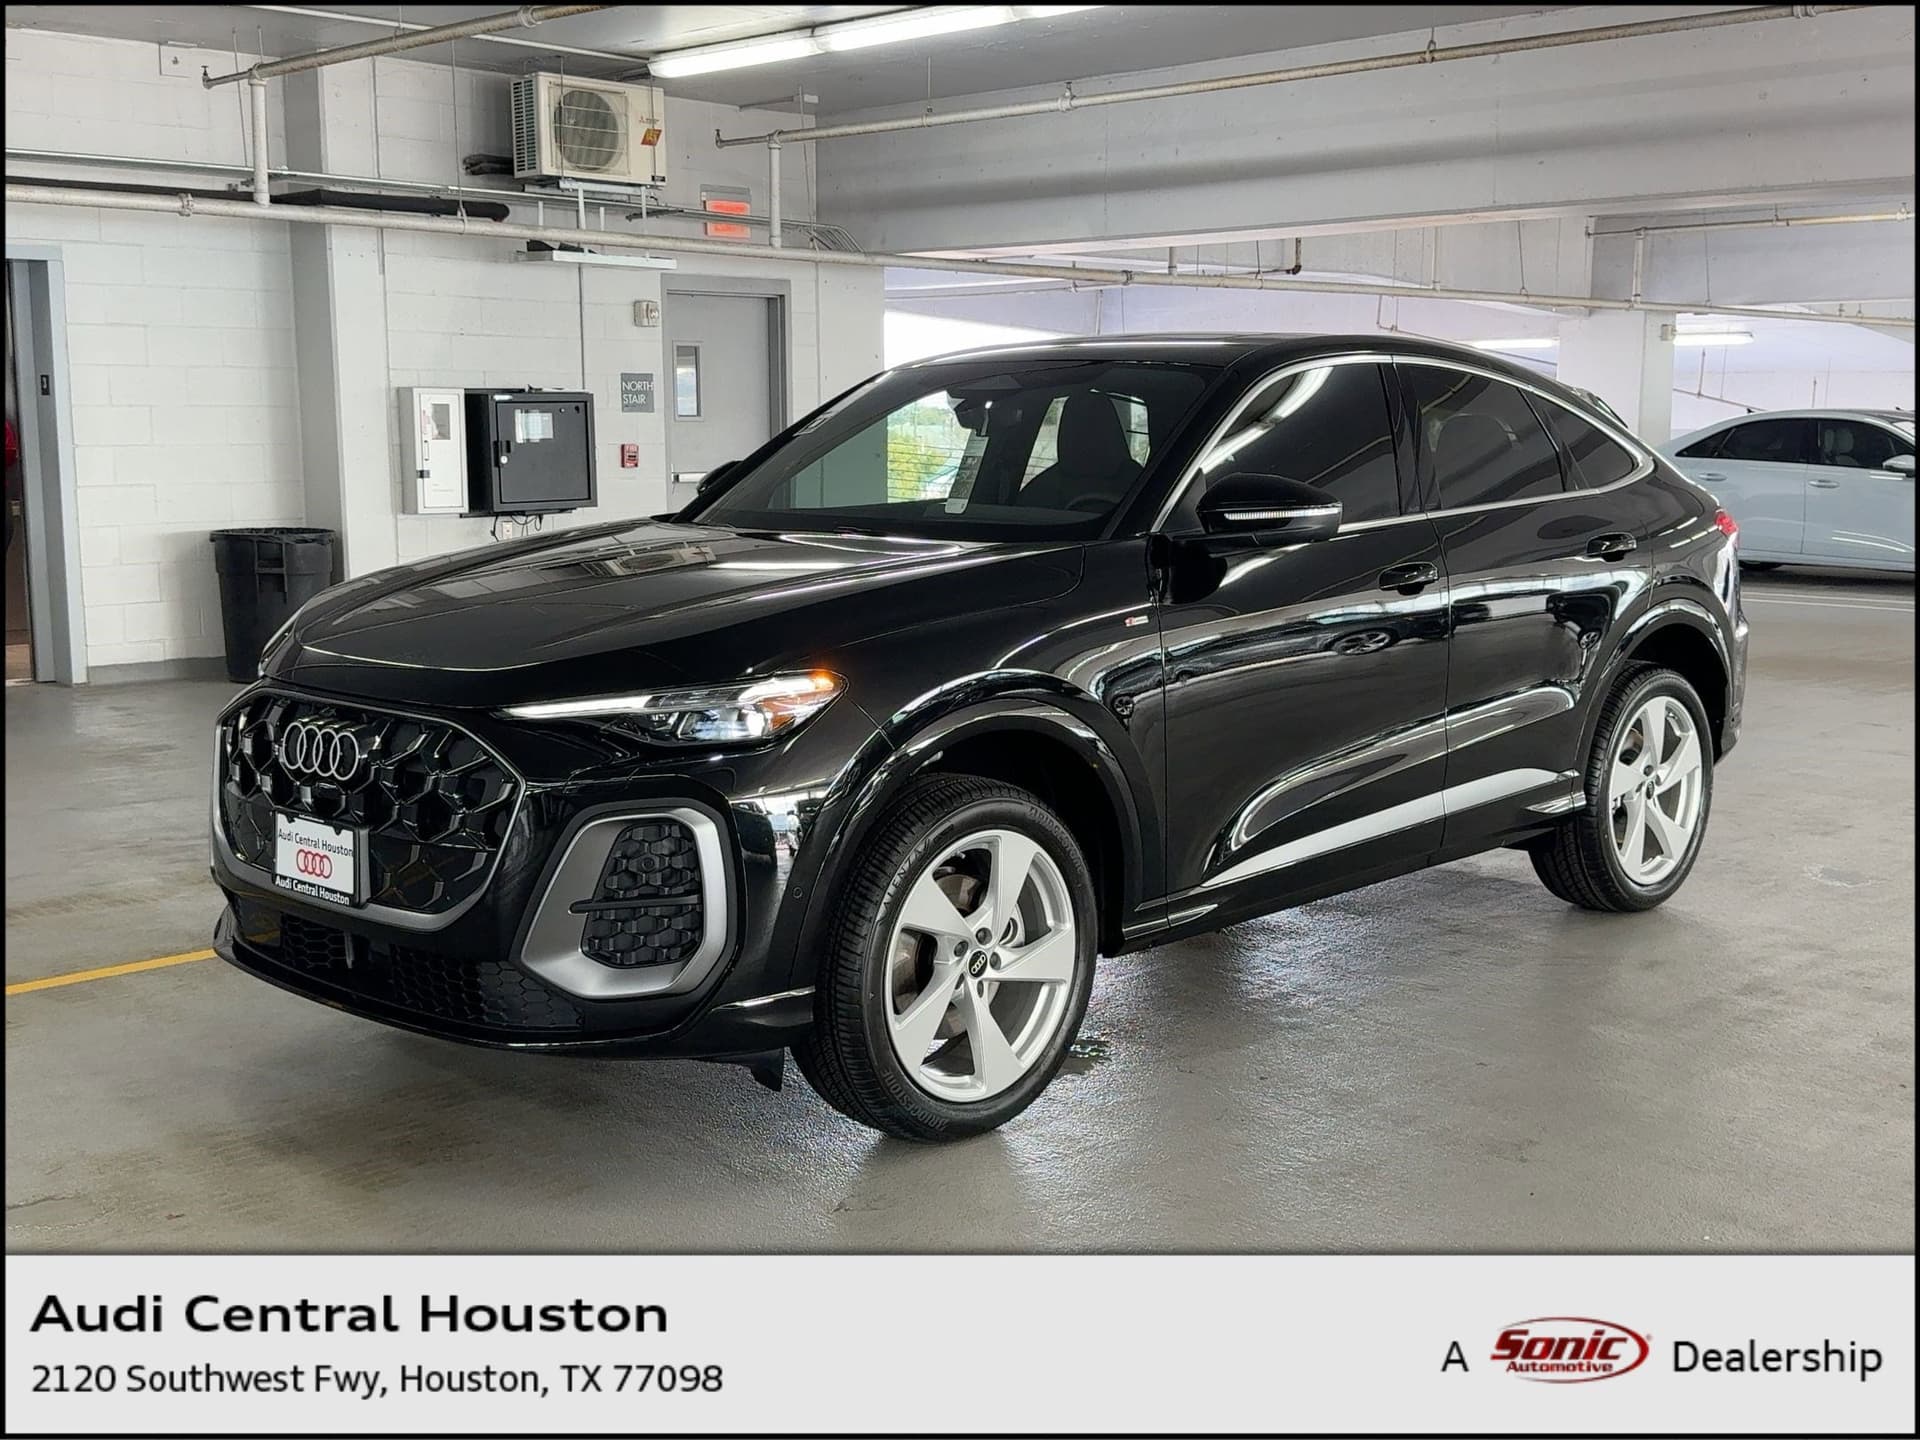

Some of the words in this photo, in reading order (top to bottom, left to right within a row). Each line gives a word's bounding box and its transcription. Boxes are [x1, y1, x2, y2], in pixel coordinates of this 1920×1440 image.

[622, 381, 654, 392] NORTH
[622, 393, 647, 405] STAIR
[278, 828, 294, 840] Audi
[294, 832, 320, 849] Central
[321, 840, 354, 857] Houston
[275, 875, 292, 889] Audi
[292, 879, 319, 898] Central
[319, 887, 350, 906] Houston
